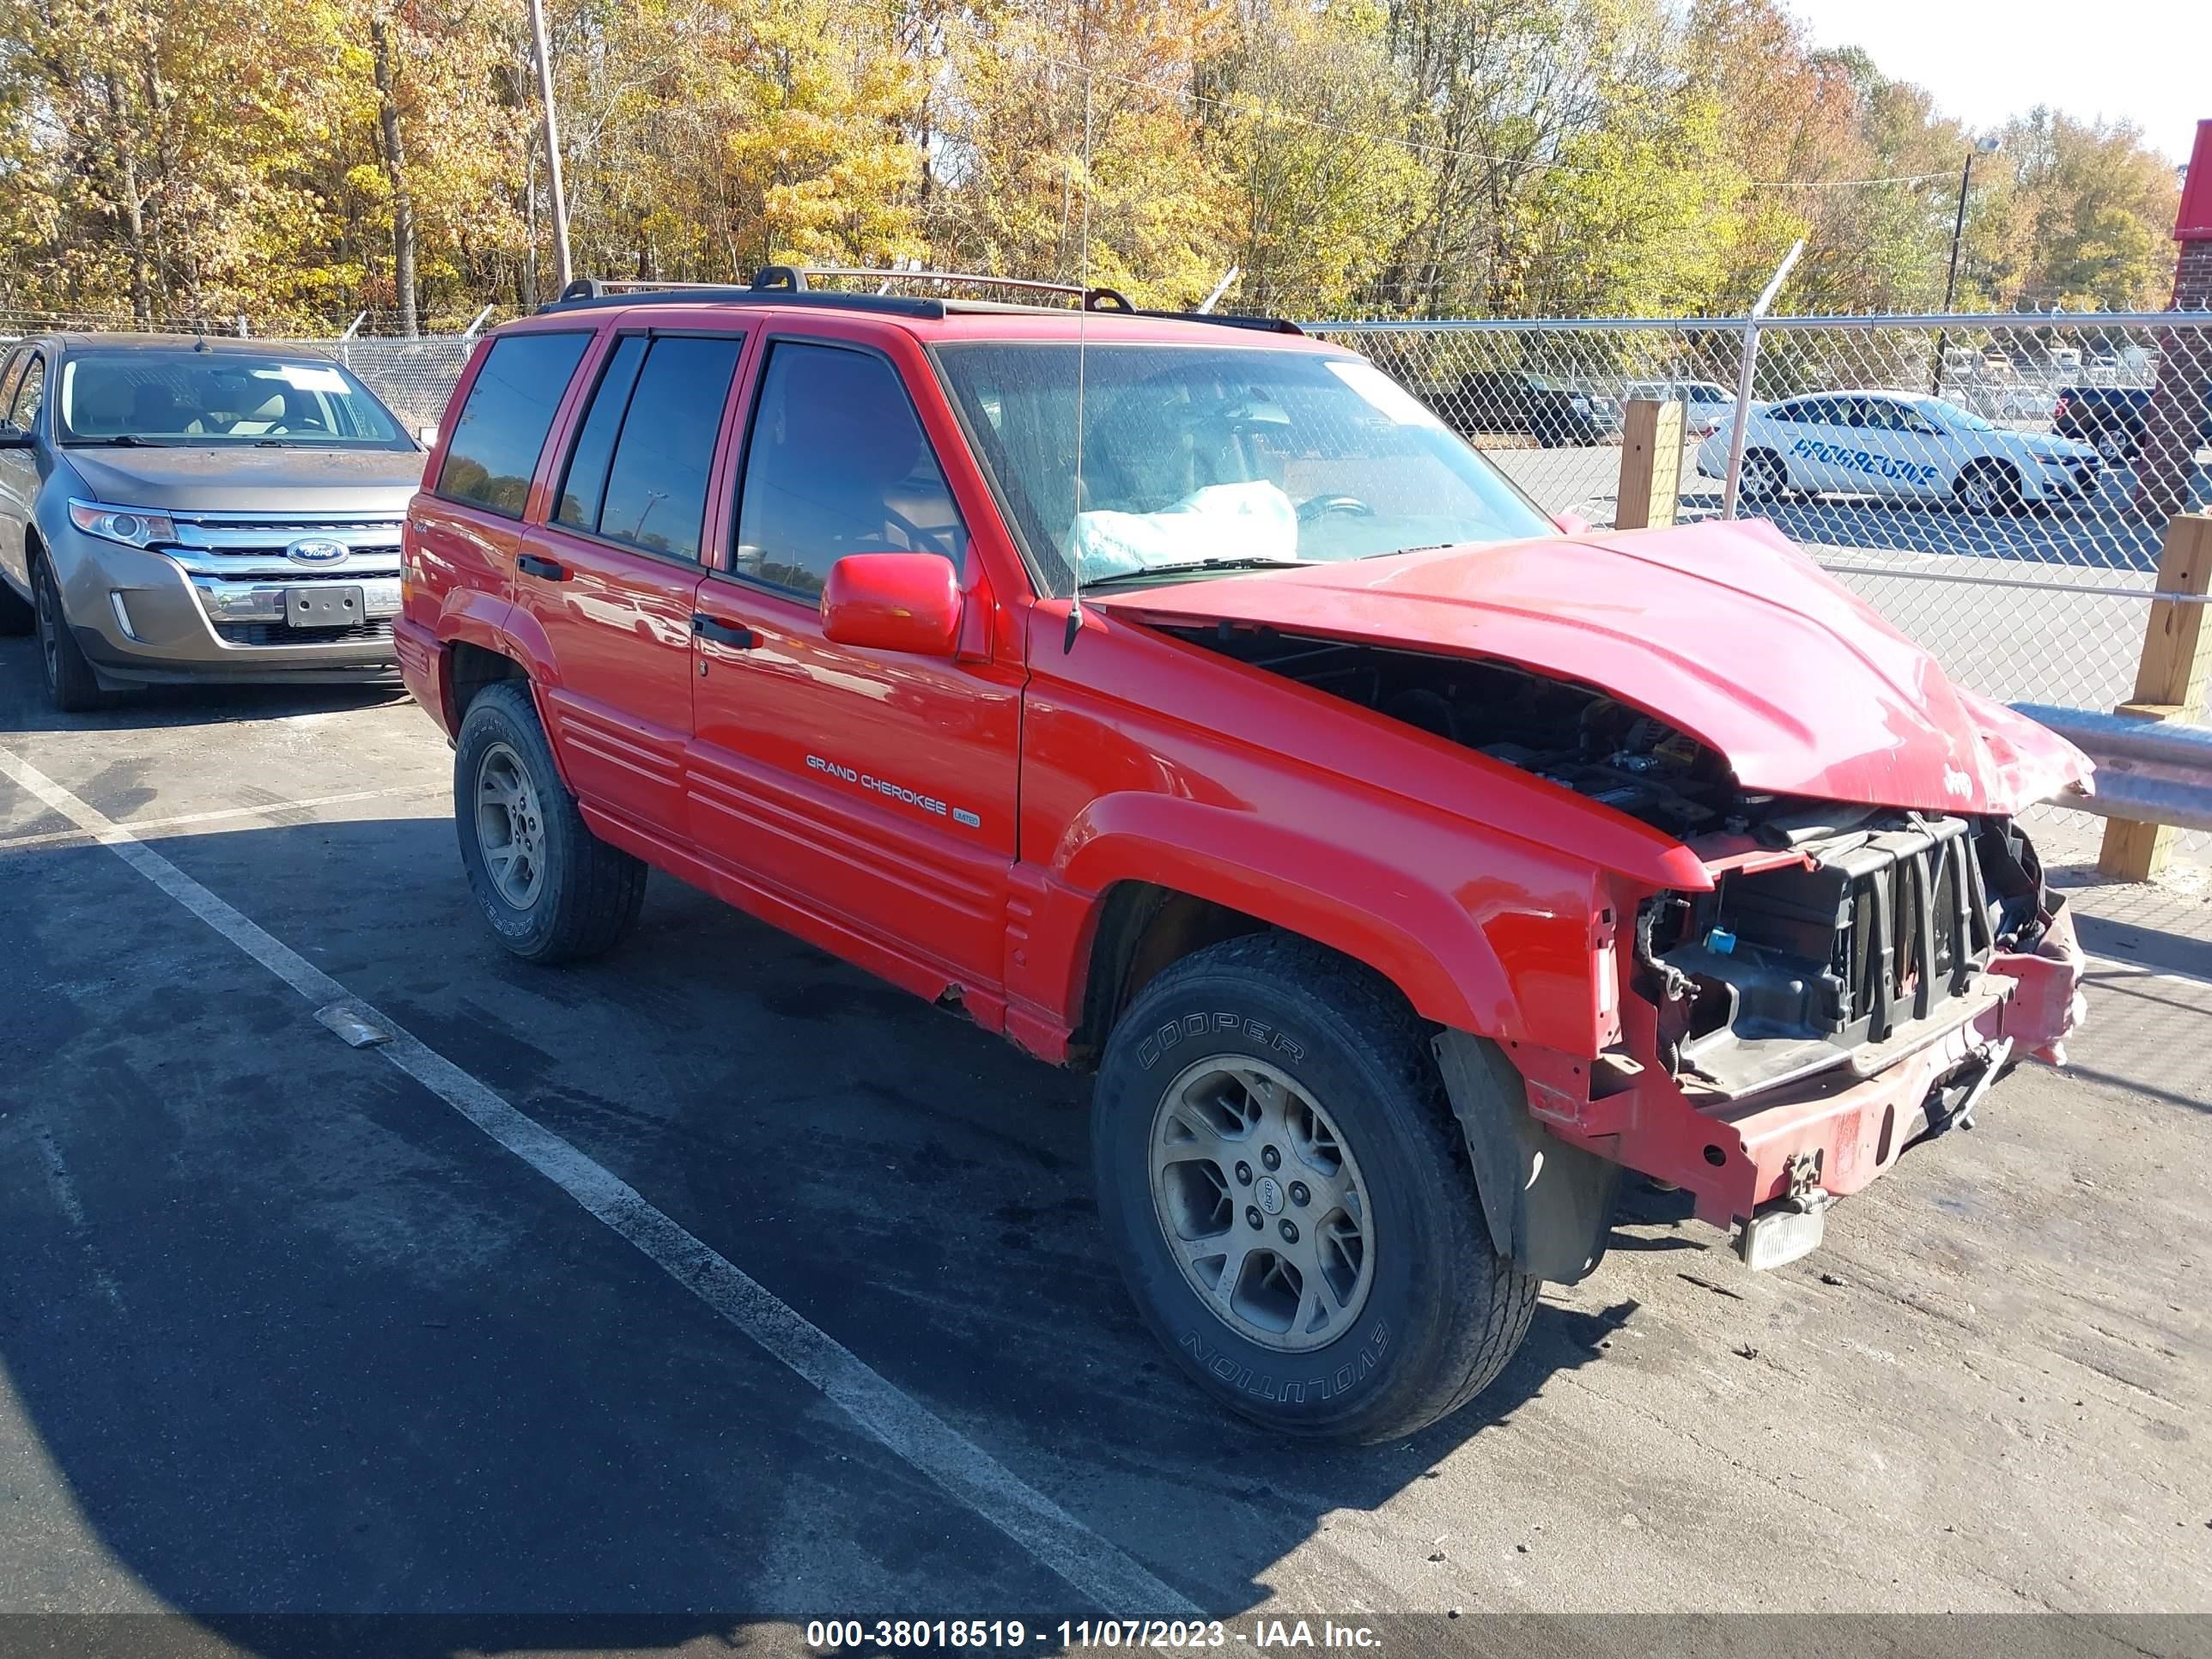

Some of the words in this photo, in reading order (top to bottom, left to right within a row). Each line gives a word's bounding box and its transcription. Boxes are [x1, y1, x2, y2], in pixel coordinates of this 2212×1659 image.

[1789, 438, 1940, 486] PROGRESSIVE
[805, 755, 858, 783] GRAND
[860, 775, 947, 816] CHEROKEE
[1135, 1012, 1306, 1071] COOPER
[1264, 1180, 1273, 1211] Jeep
[1180, 1317, 1392, 1403] EVOLUTION
